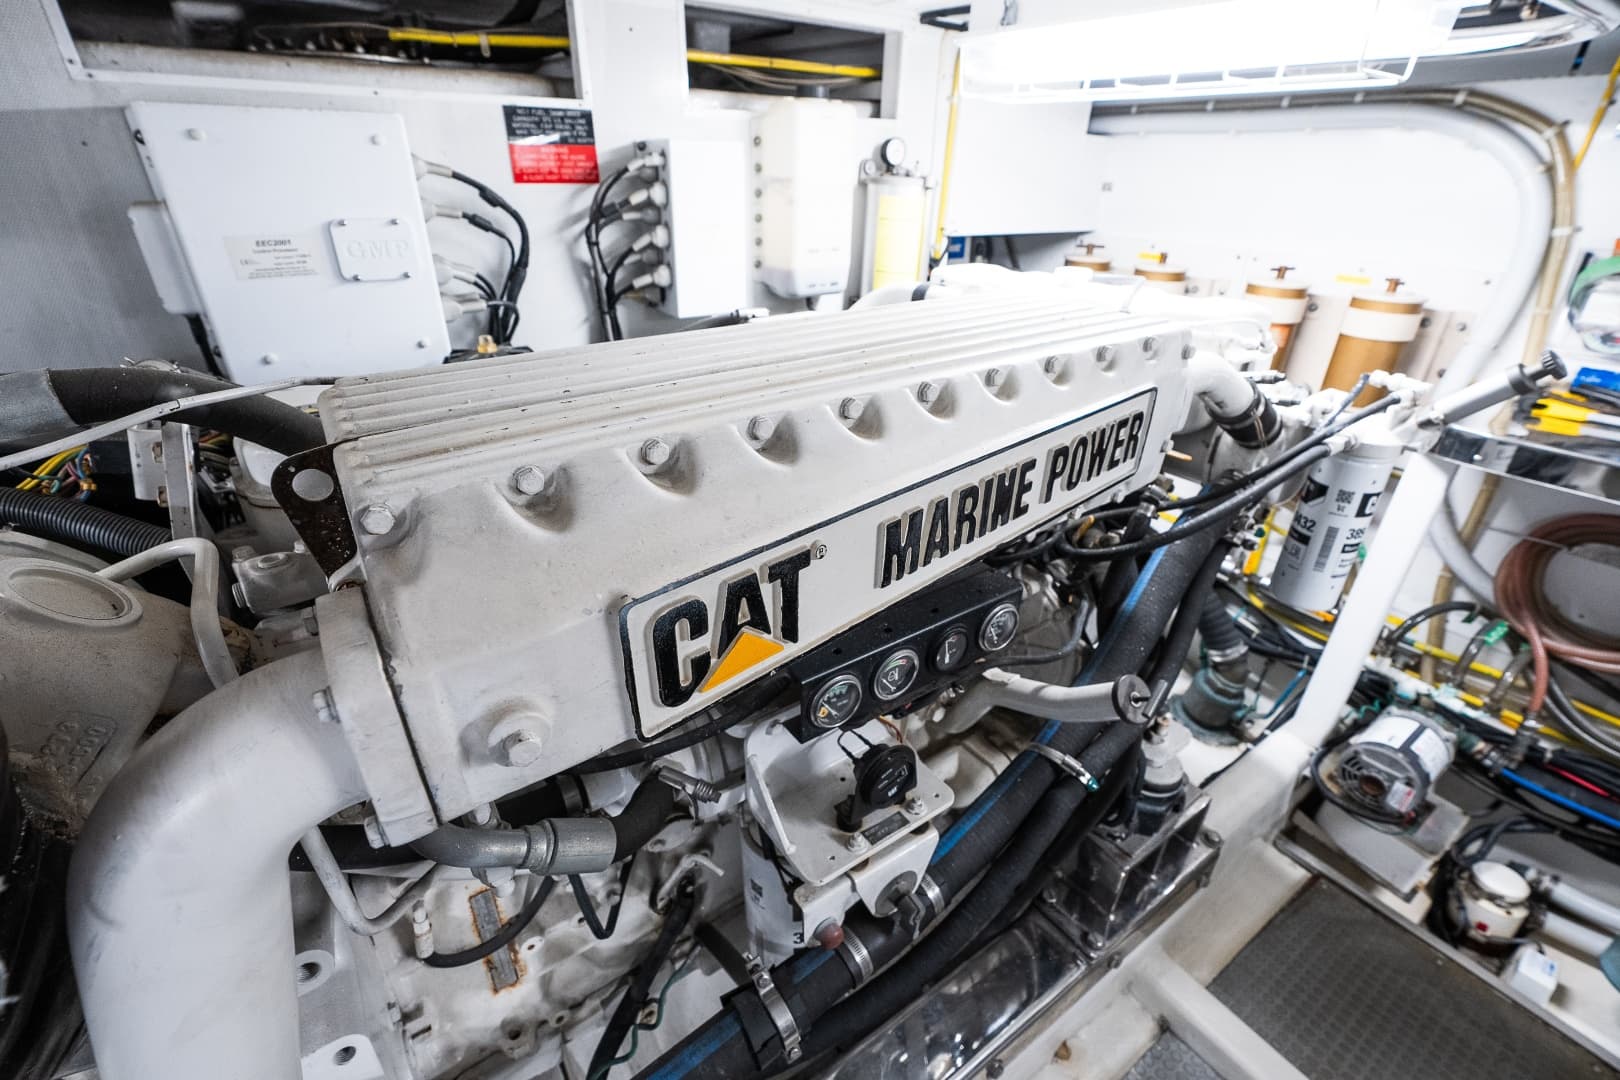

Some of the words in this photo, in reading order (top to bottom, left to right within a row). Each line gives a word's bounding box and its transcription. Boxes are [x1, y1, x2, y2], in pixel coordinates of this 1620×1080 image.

[652, 546, 812, 708] CAT
[875, 457, 1038, 589] MARINE
[1042, 409, 1146, 504] POWER
